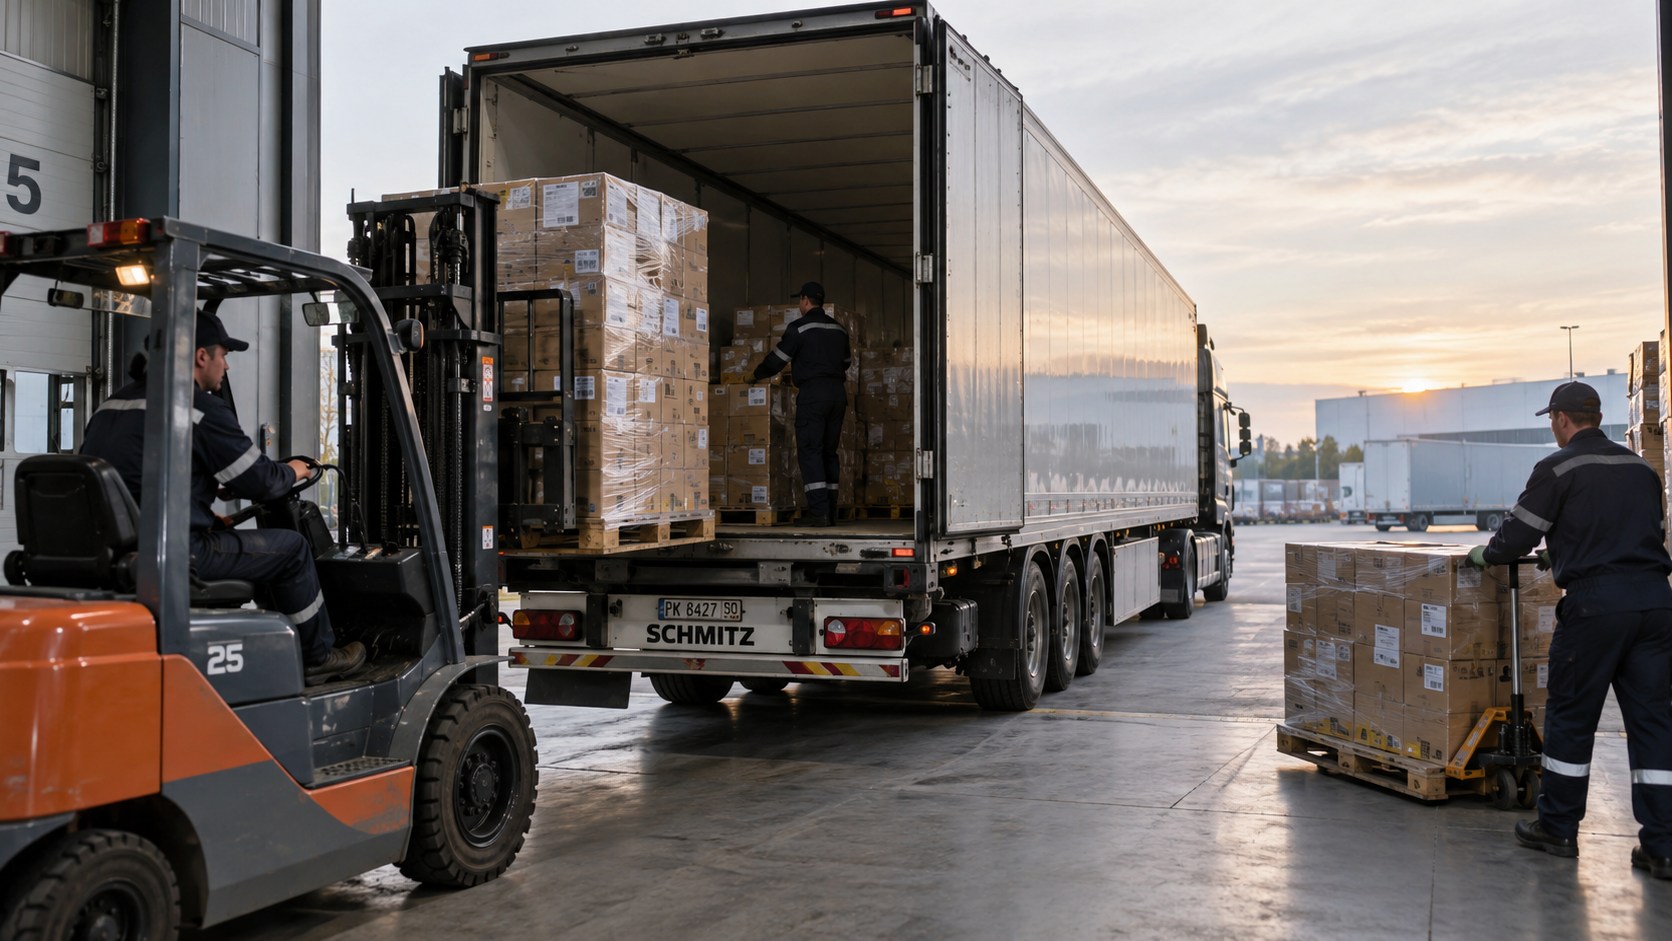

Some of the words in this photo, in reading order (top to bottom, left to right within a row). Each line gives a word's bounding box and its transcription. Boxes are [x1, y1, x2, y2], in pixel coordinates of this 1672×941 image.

[6, 153, 42, 215] 5
[665, 601, 681, 617] PK
[686, 602, 718, 617] 8427
[646, 624, 755, 646] SCHMITZ
[207, 643, 244, 675] 25
